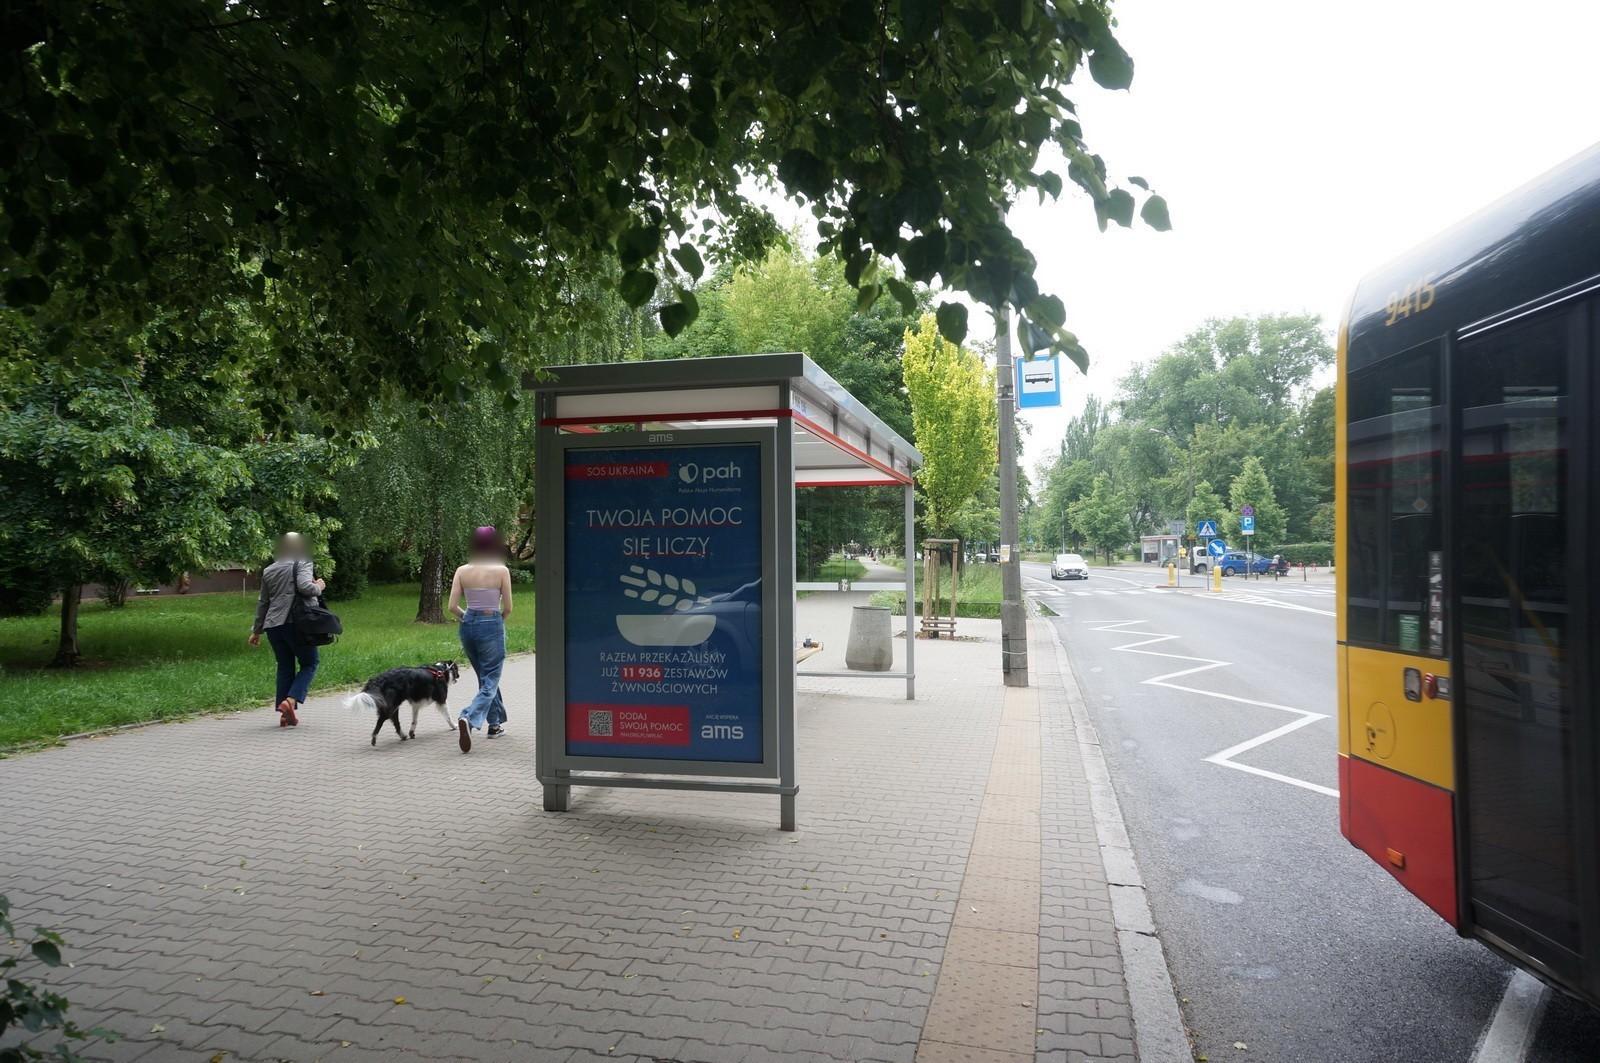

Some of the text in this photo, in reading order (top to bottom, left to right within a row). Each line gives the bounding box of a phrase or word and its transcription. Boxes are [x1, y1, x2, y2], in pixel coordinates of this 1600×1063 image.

[1385, 278, 1435, 326] 9415
[648, 433, 674, 443] ams
[587, 465, 655, 477] SOS UKRAINA
[702, 461, 742, 484] pah
[586, 507, 743, 527] TWOJA POMOC
[1244, 517, 1251, 526] P
[624, 536, 710, 559] SIĘ LICZY
[600, 650, 726, 664] RAZEM PRZEKAZALIŚMY
[601, 665, 728, 679] JUŻ 11 936 ZESTAWÓW
[611, 681, 718, 695] ŻYWNOŚCIOWYCH
[619, 711, 647, 721] DODAJ
[619, 721, 684, 732] SWOJĄ POMOC
[701, 724, 744, 740] ams
